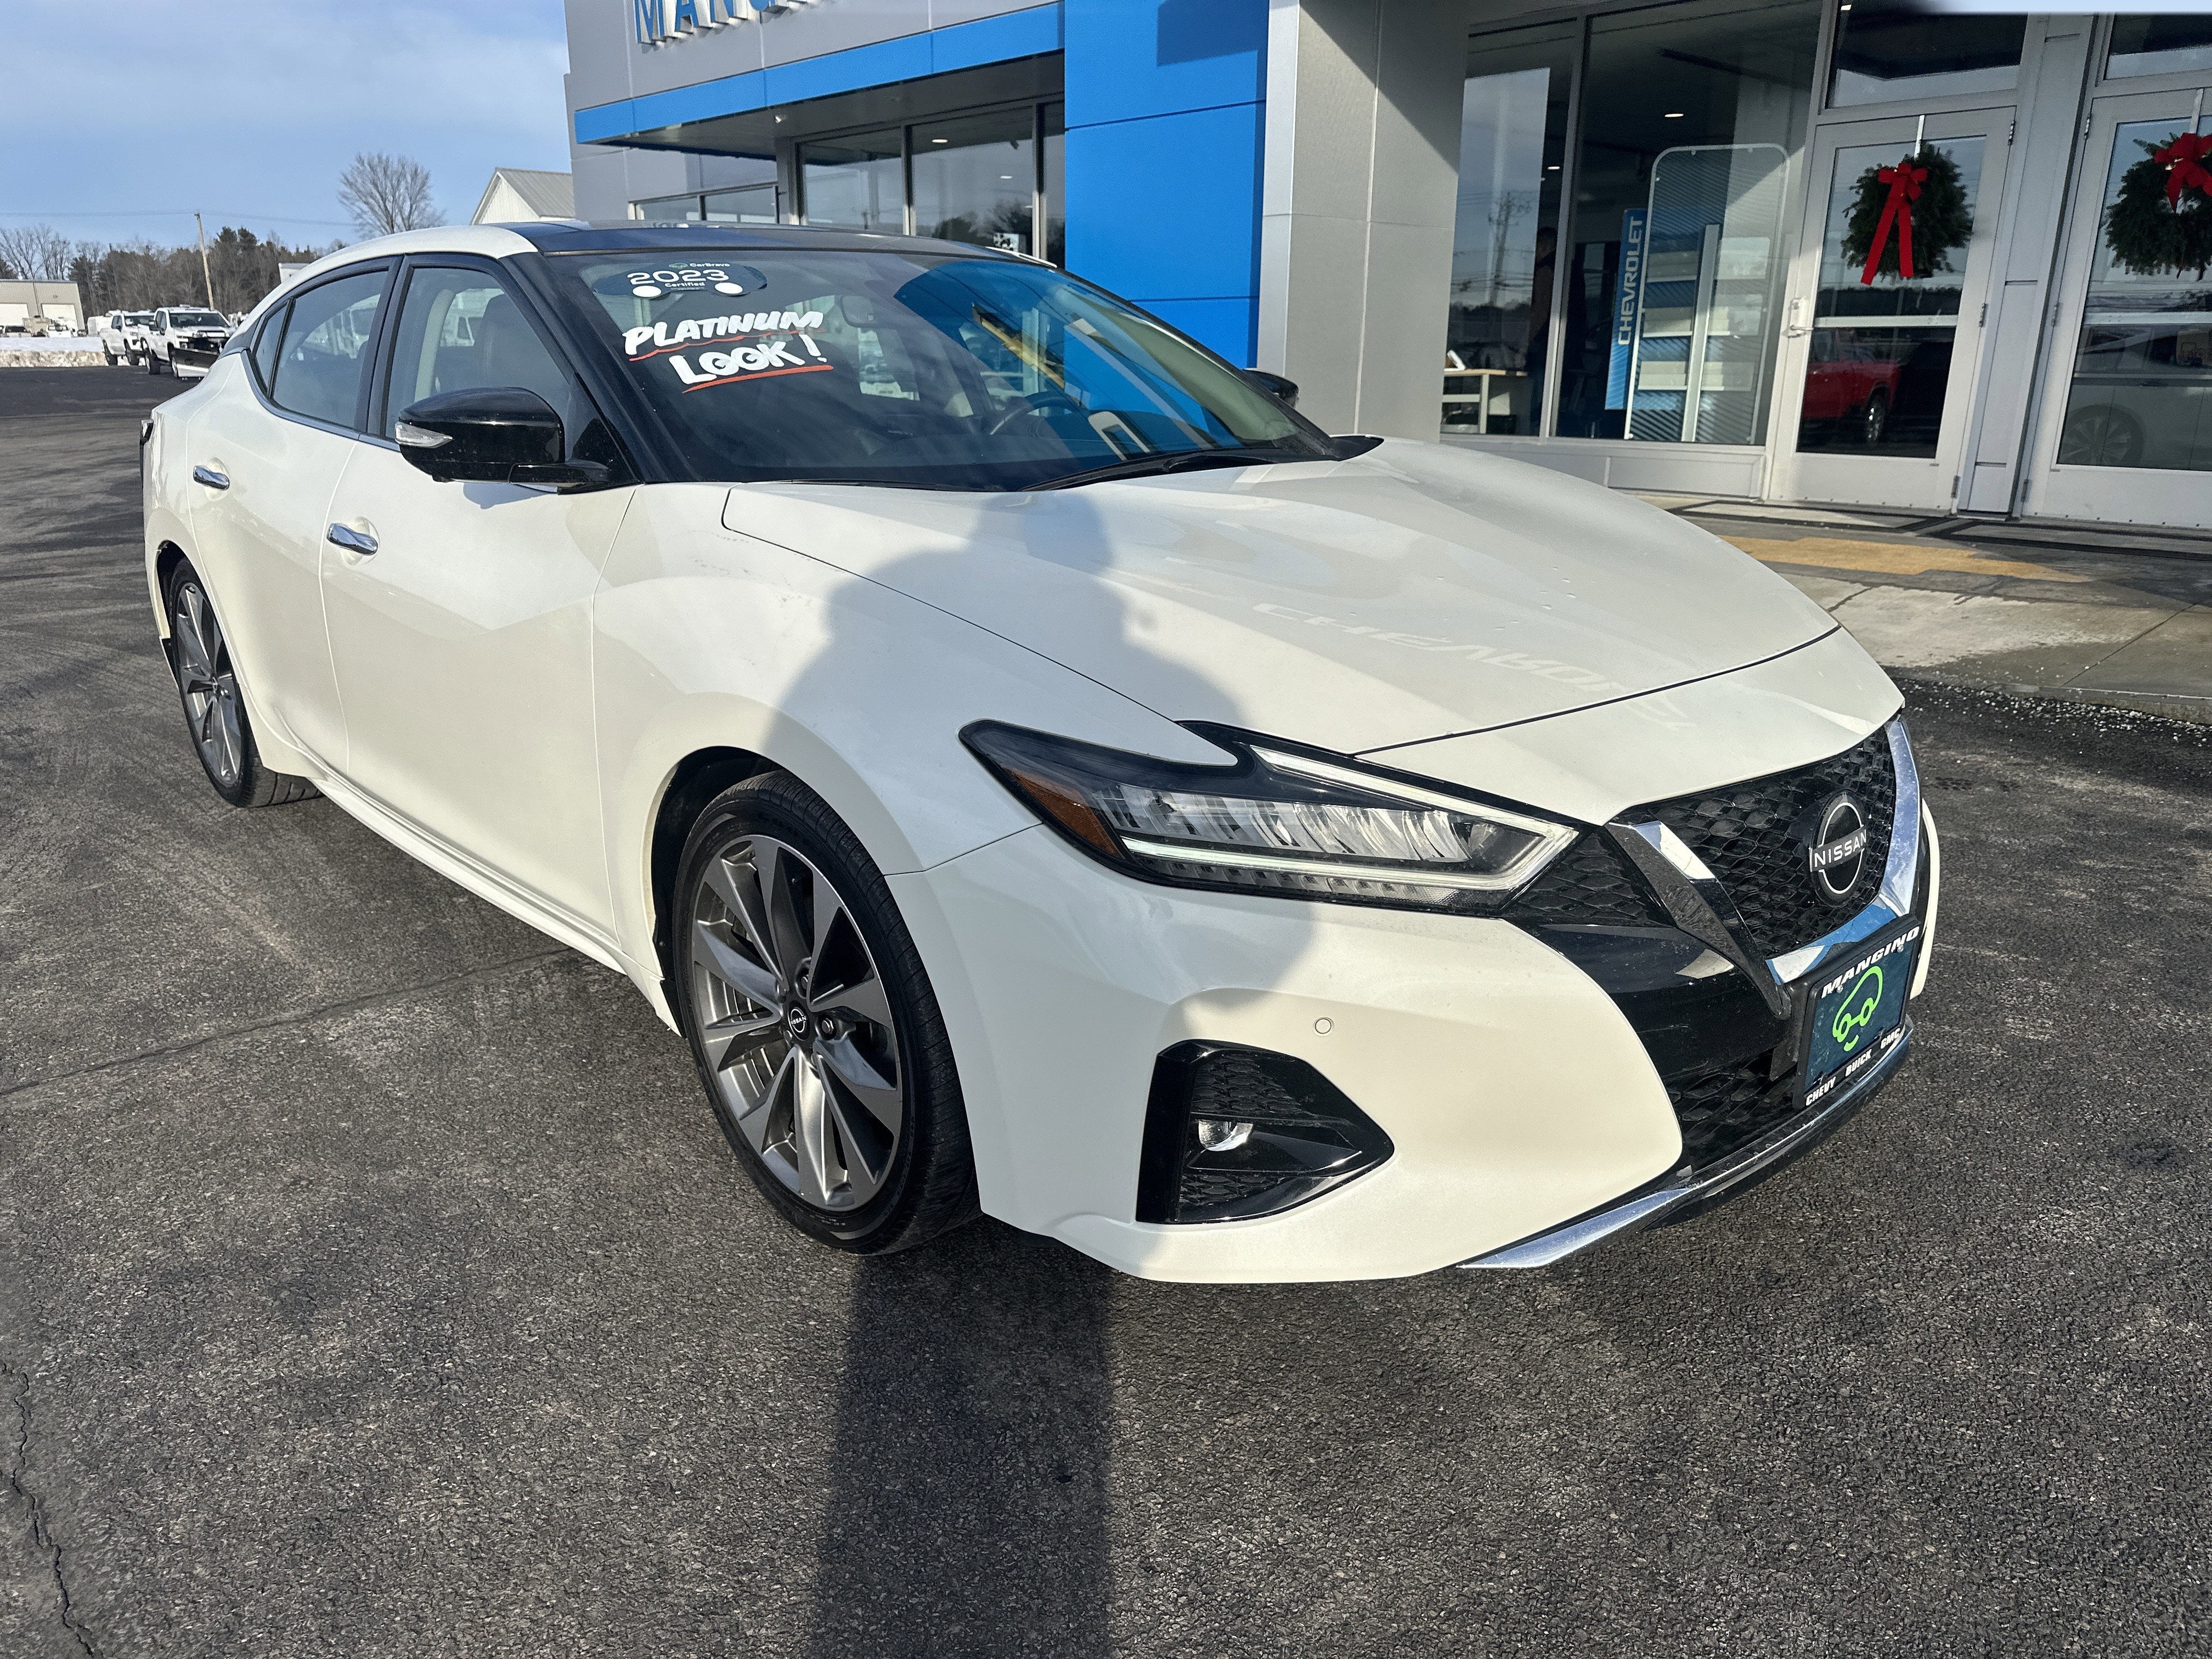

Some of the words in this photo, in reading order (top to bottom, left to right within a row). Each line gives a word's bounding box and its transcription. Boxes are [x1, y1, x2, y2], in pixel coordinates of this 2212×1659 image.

[627, 269, 729, 285] 2023
[1618, 216, 1643, 345] CHEVROLET
[622, 311, 823, 355] PLATINUM
[1814, 830, 1866, 867] NISSAN
[1821, 926, 1920, 999] MANGINO
[1805, 1076, 1836, 1106] CHEVY
[1845, 1049, 1872, 1076] BUICK
[1880, 1028, 1900, 1049] GMC
